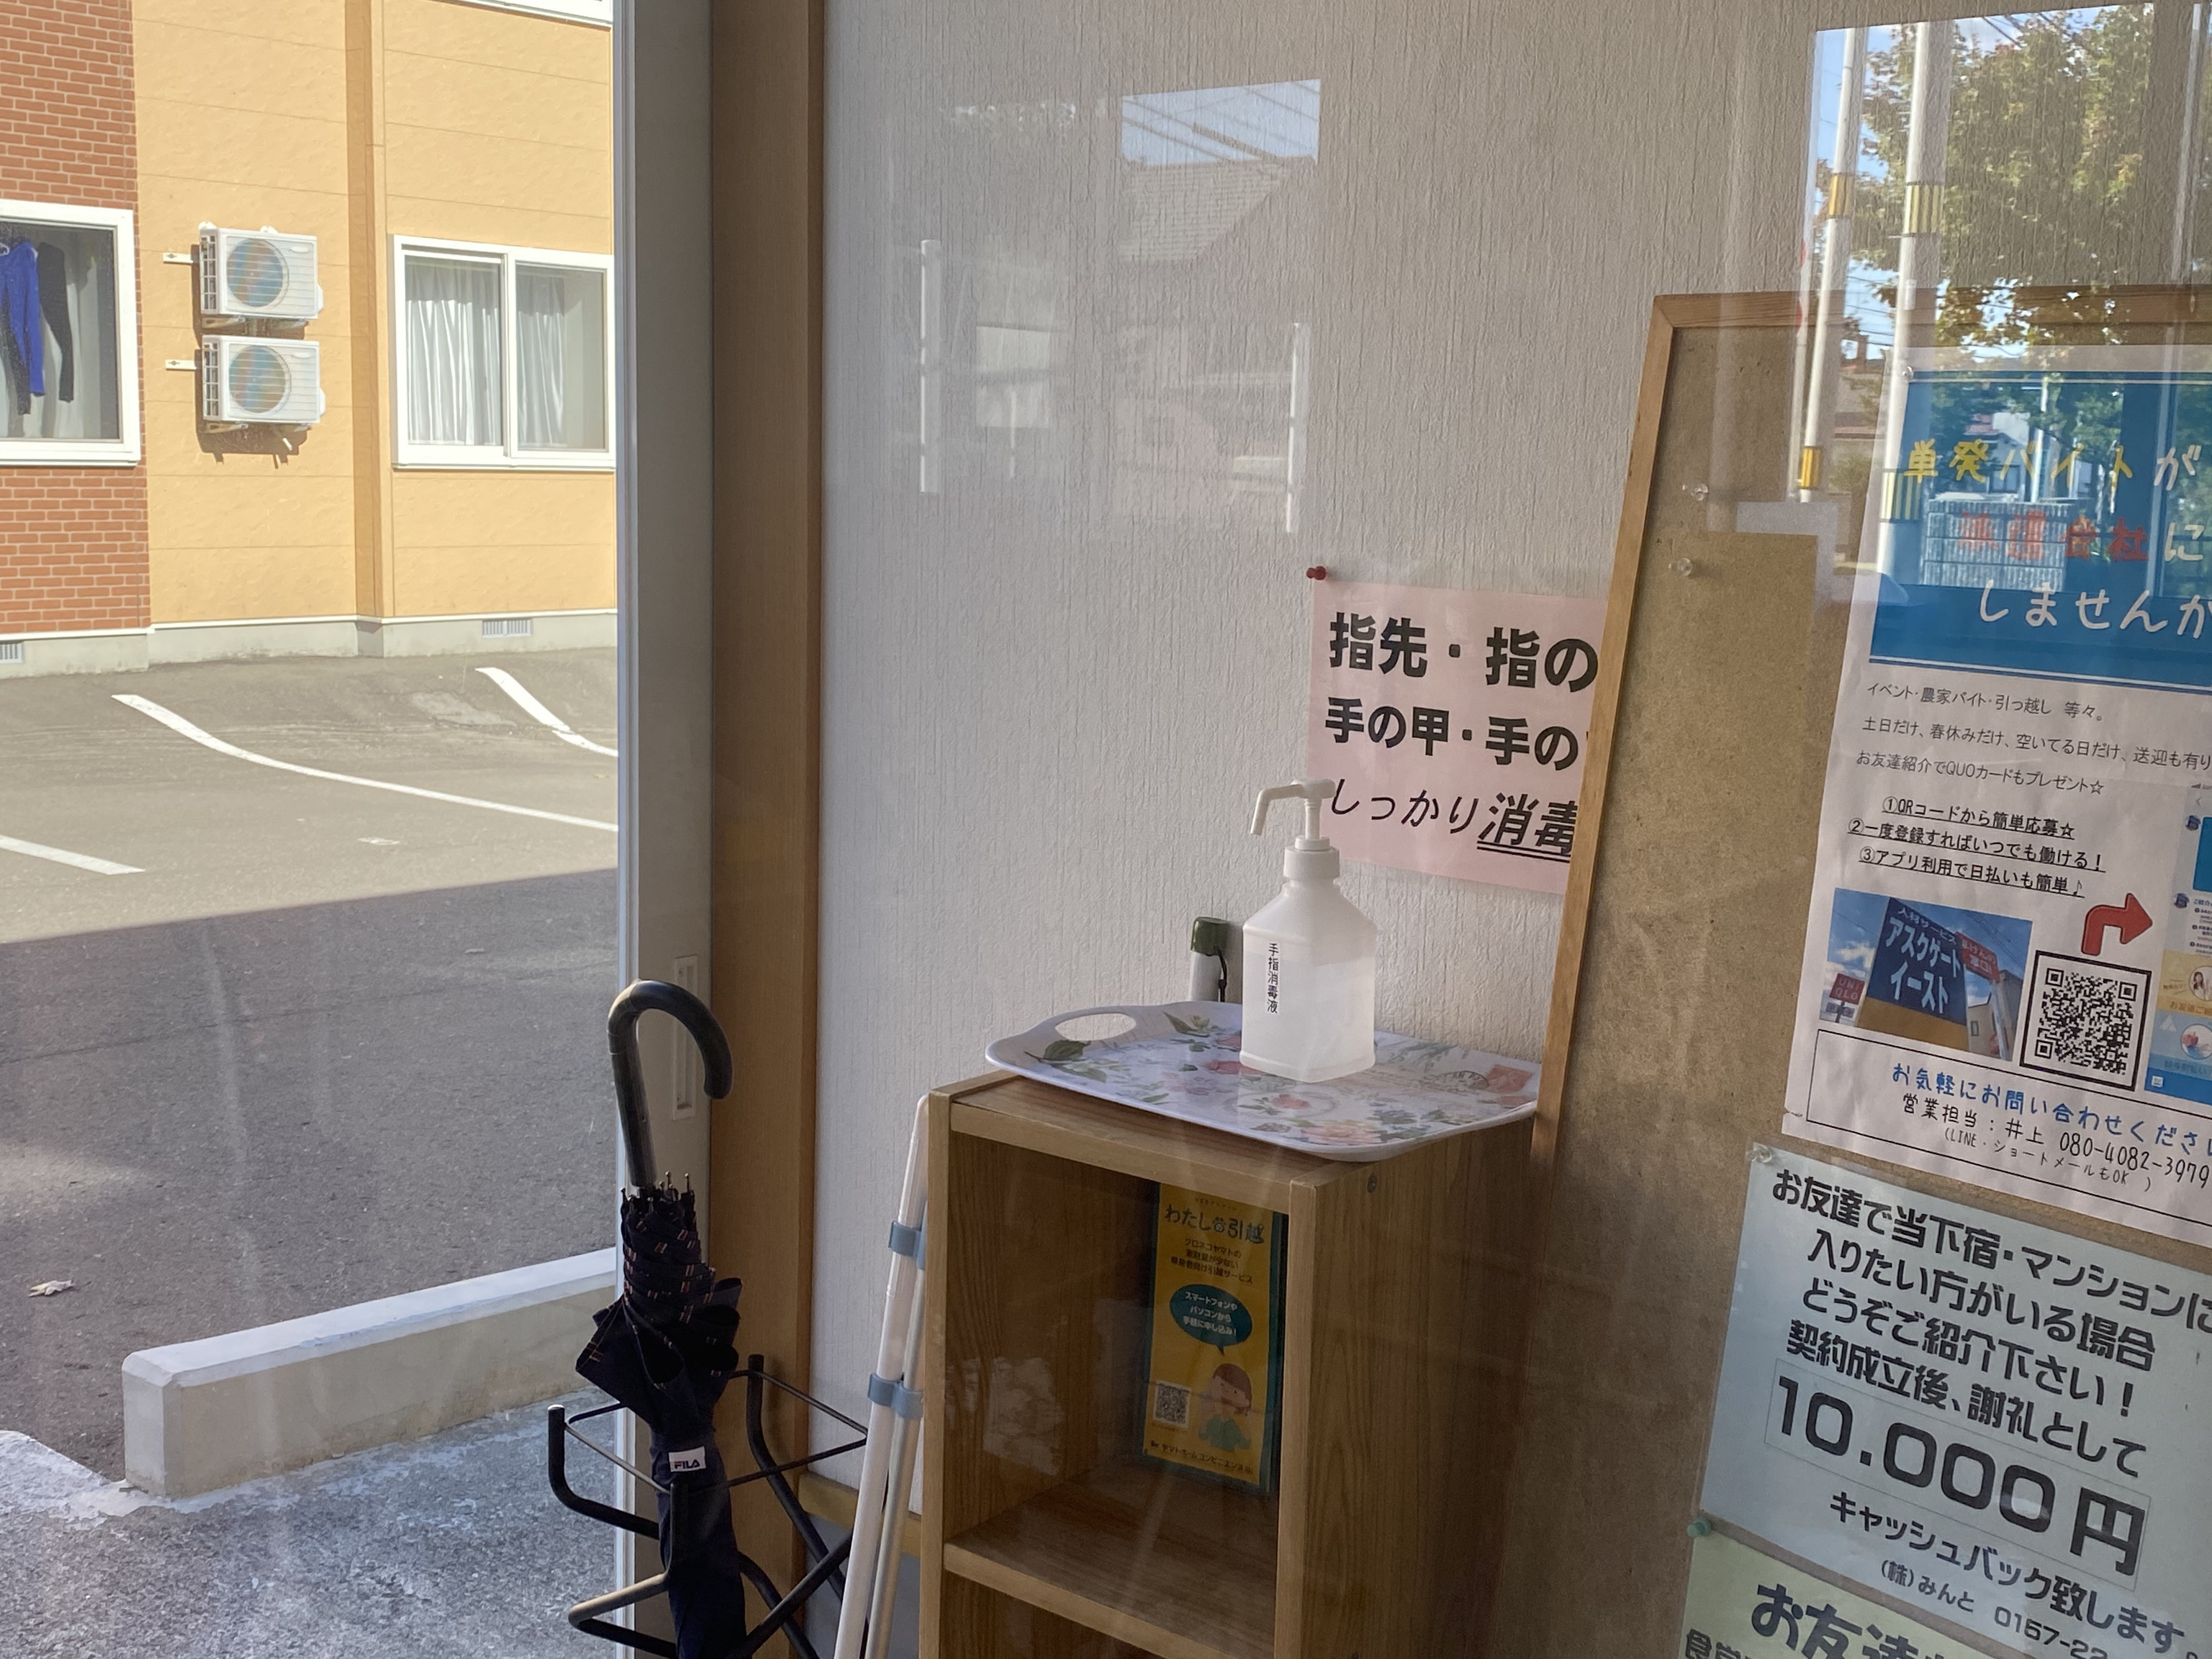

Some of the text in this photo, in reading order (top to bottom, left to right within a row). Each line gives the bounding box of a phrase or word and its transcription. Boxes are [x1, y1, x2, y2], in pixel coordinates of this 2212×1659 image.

[1325, 697, 1589, 771] 手の甲・手の
[1330, 778, 1578, 856] しっかり消毒
[1267, 943, 1279, 1014] 手指消毒液
[1886, 916, 1961, 978] アスクゲート
[1891, 961, 1949, 1014] イースト
[2060, 1131, 2210, 1189] 080-4082-3979
[1808, 1228, 2155, 1372] 入りたい方がいる場合
[1786, 1319, 2147, 1479] 契約成立後、謝礼として
[674, 1459, 700, 1469] FILA
